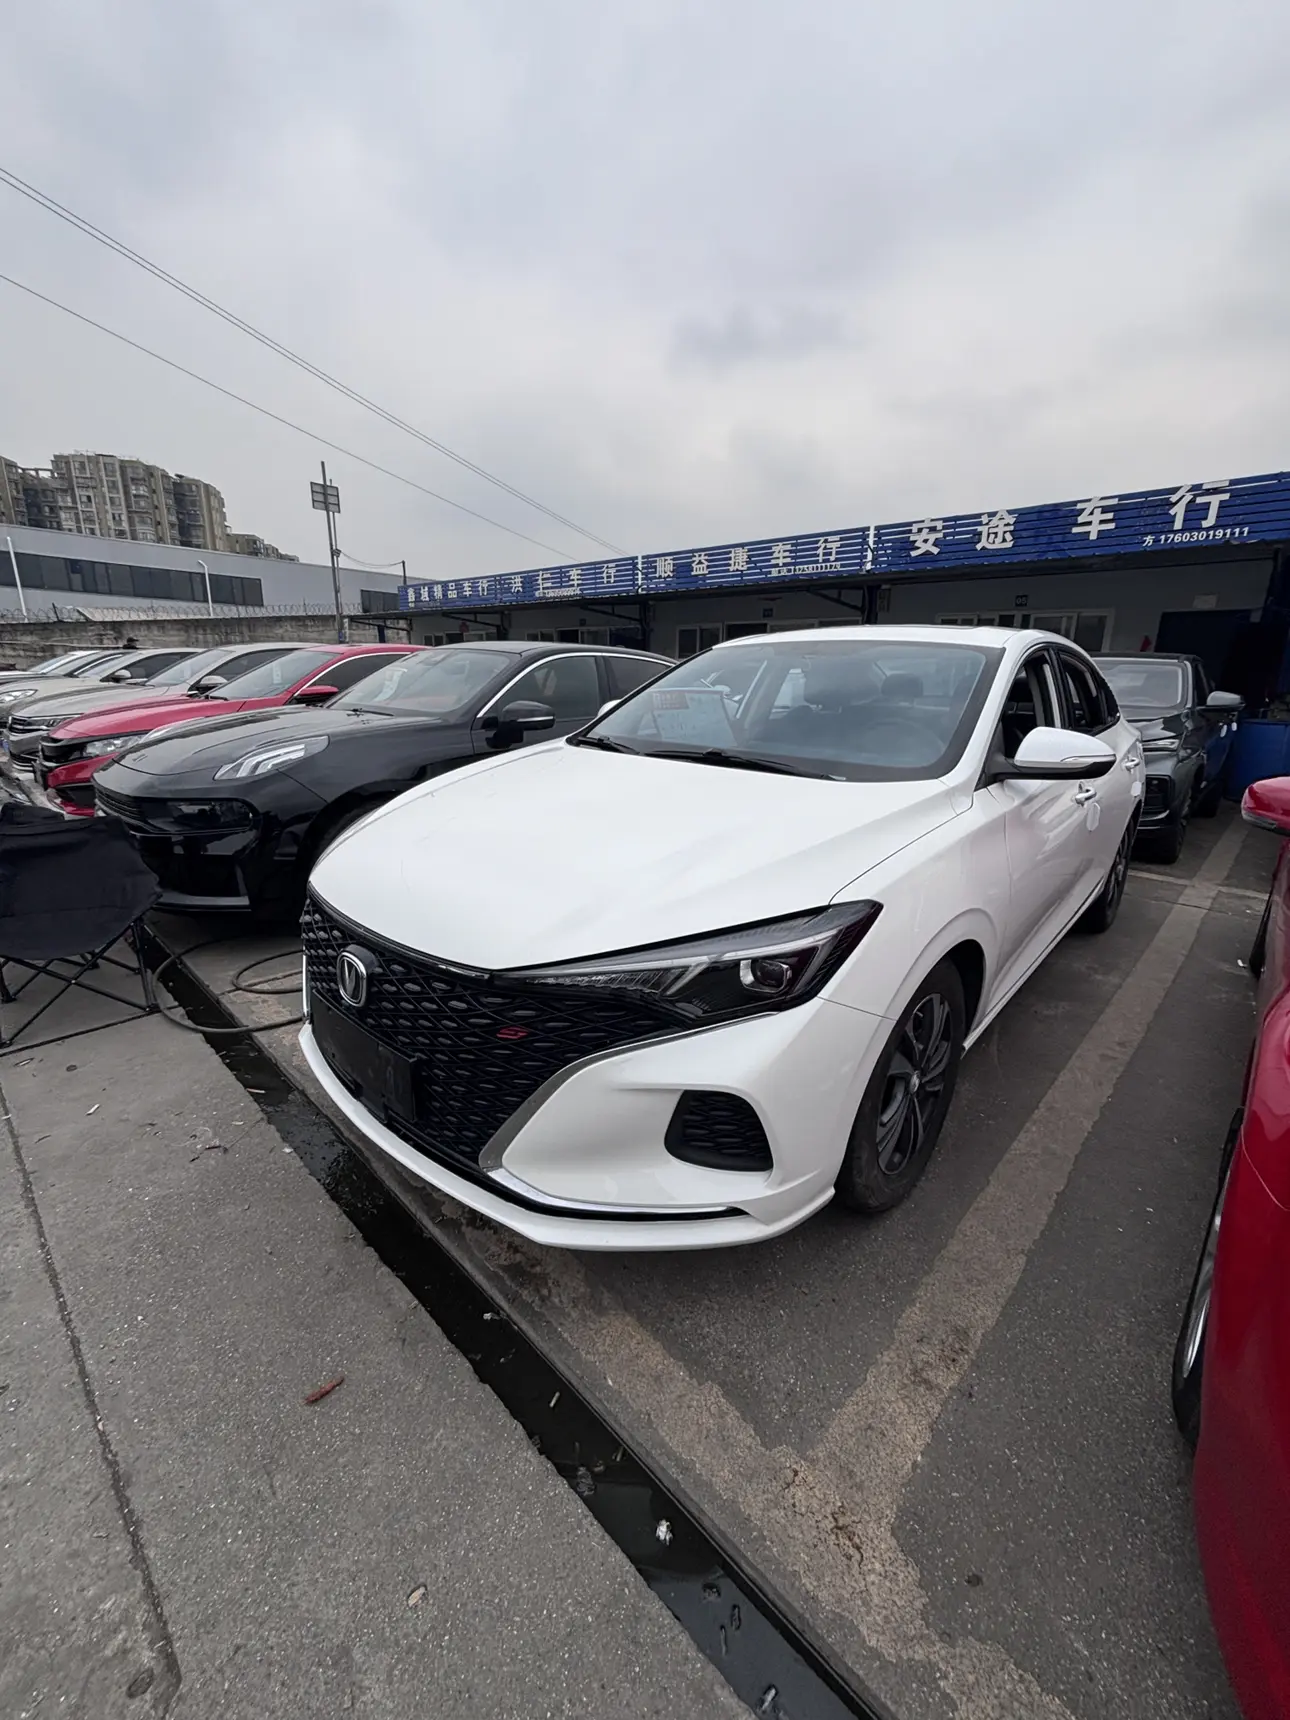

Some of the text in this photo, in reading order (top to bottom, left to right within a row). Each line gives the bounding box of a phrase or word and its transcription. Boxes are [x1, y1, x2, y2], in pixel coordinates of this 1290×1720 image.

[909, 480, 1230, 556] 安途车行
[1142, 526, 1250, 547] 方 17603019111
[655, 536, 841, 578] 顺益捷车行
